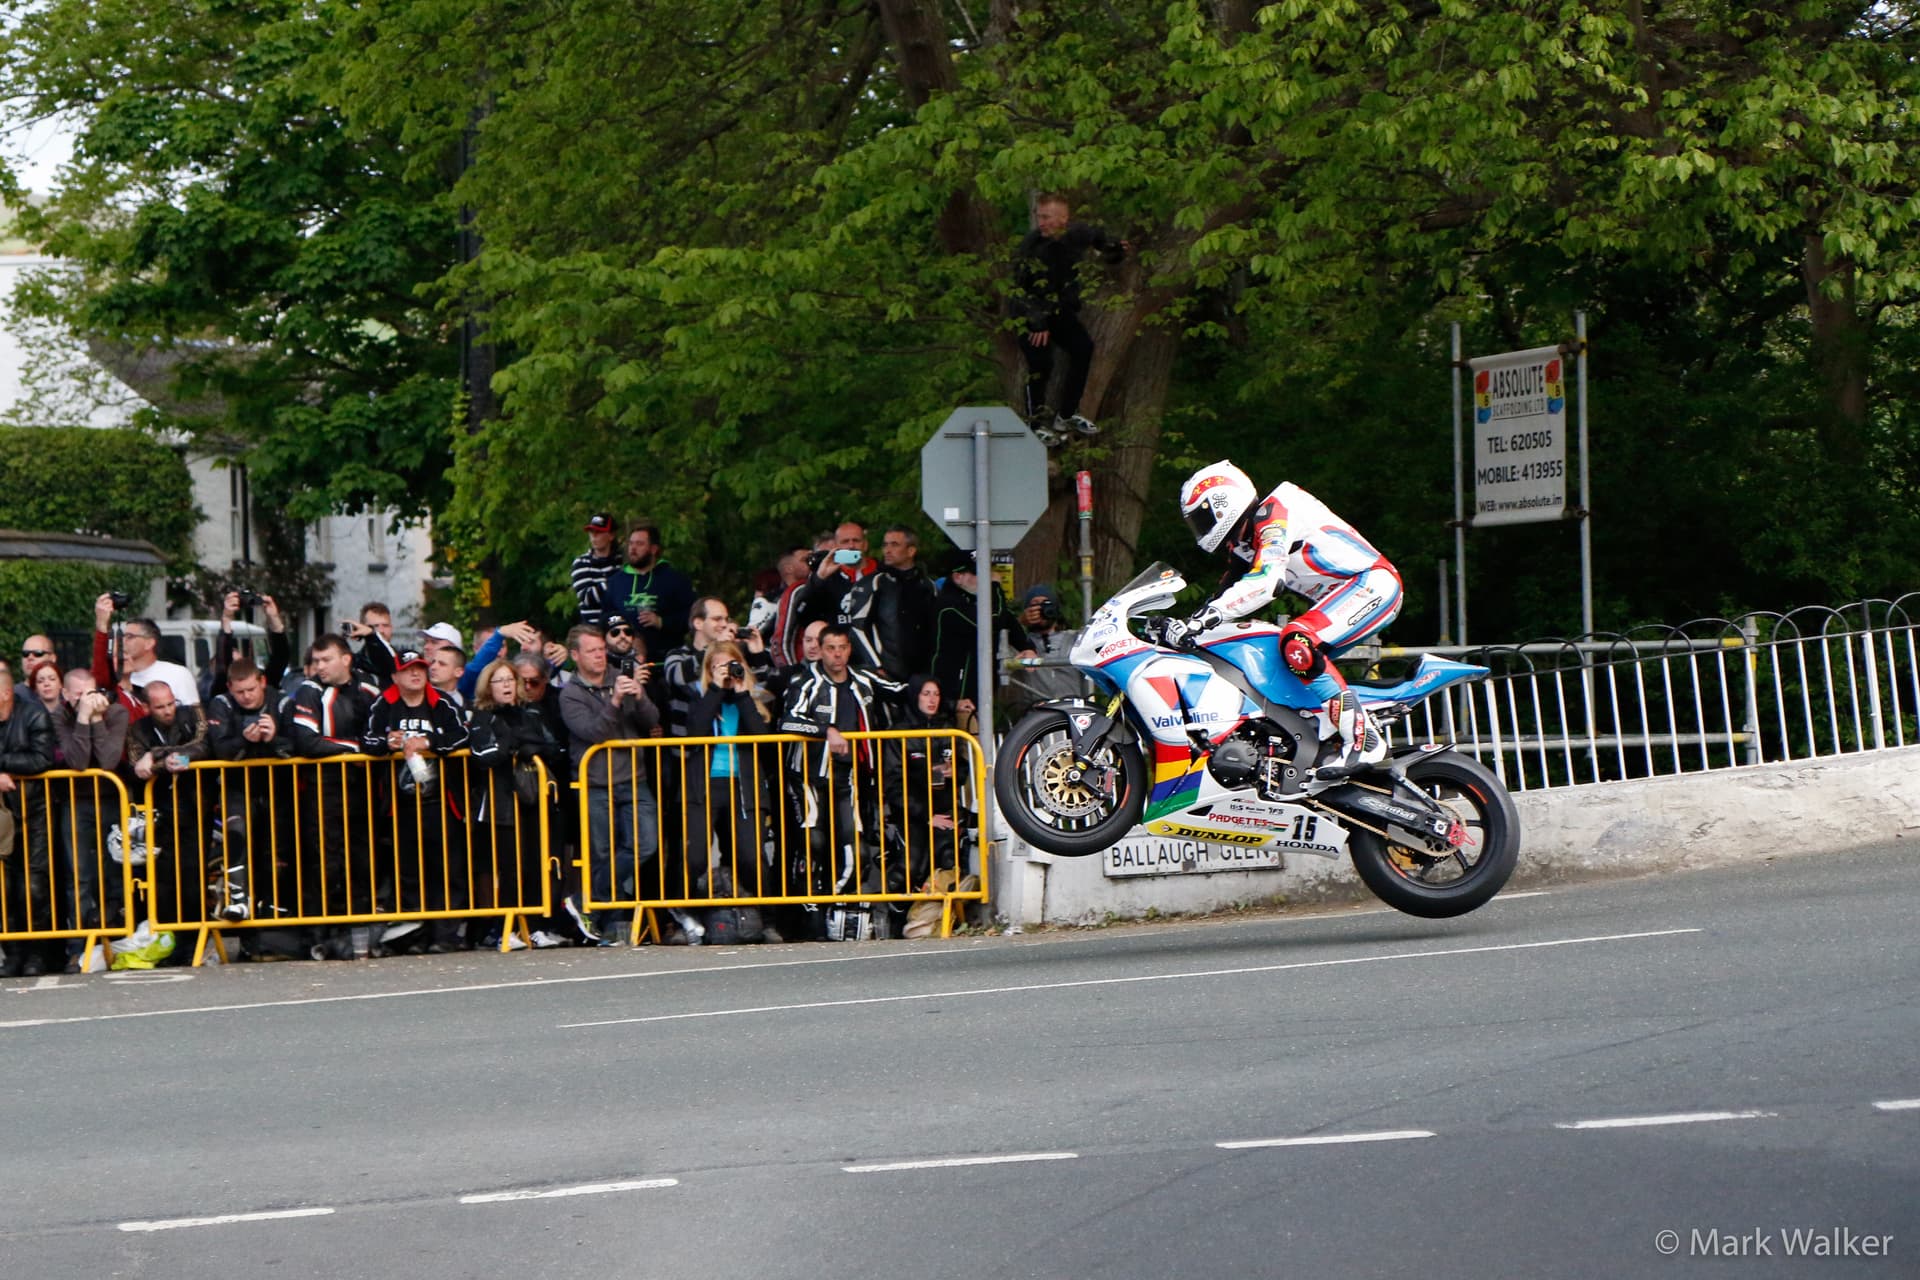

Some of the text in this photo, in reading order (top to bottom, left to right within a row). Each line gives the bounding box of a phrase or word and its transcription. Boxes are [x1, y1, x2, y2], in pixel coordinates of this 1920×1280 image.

[1493, 365, 1543, 399] ABSOLUTE
[1487, 431, 1552, 454] TEL: 620505
[1478, 460, 1562, 486] MOBILE: 413955
[1498, 494, 1562, 509] www.absolute.im
[1176, 828, 1262, 844] DUNLOP
[1292, 815, 1318, 841] 15
[1112, 842, 1208, 867] BALLAUGH
[1276, 840, 1339, 853] HONDA
